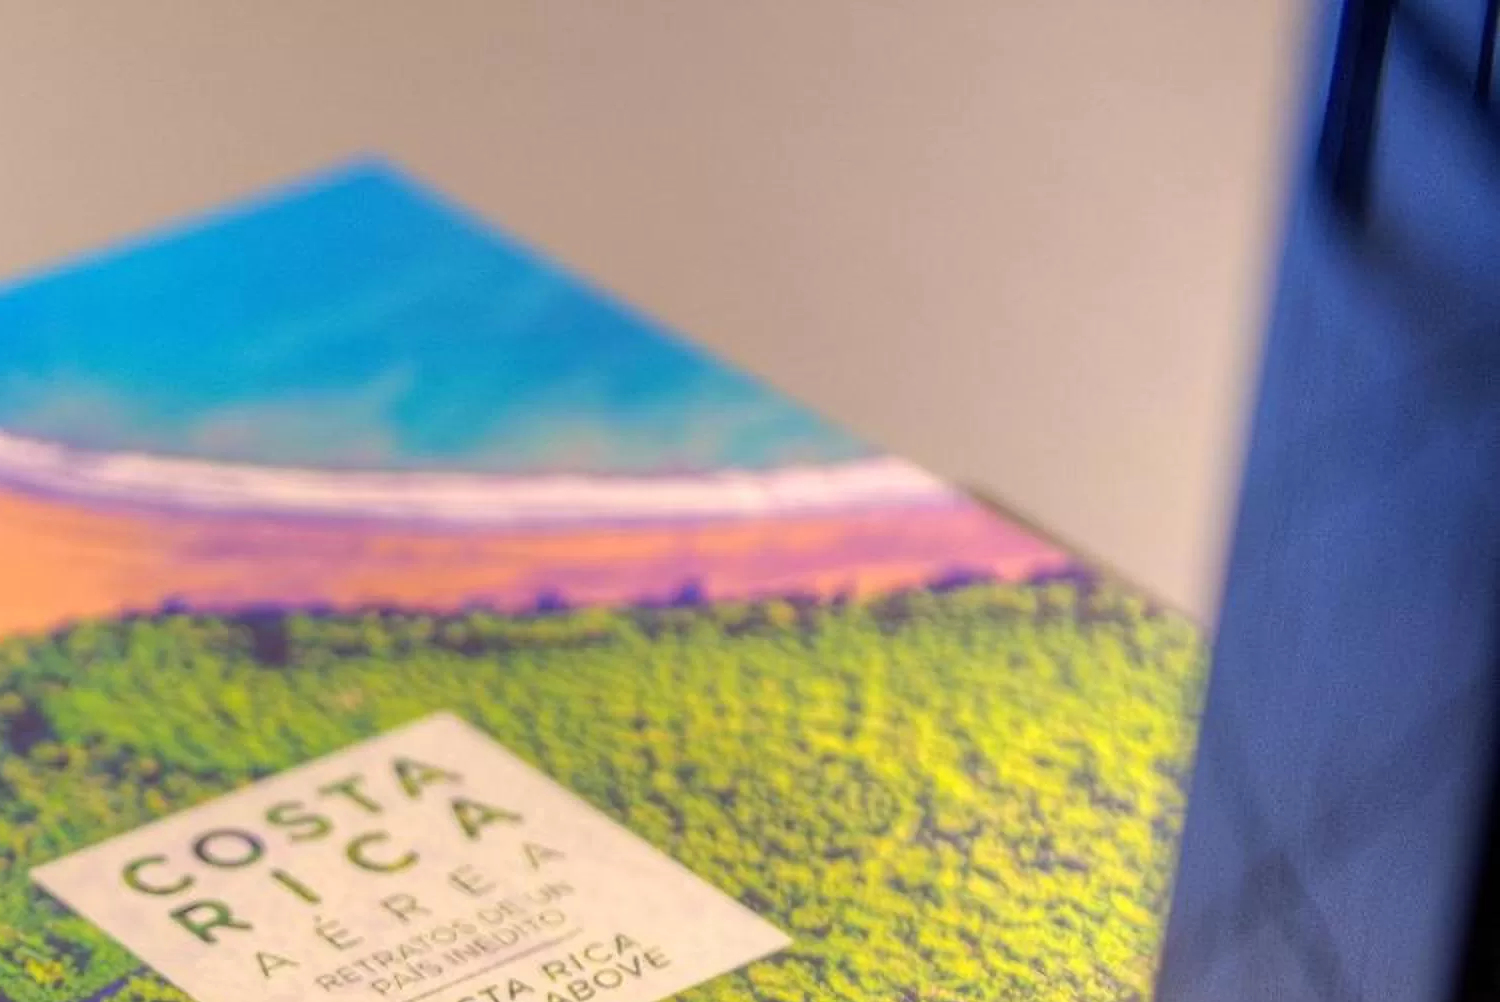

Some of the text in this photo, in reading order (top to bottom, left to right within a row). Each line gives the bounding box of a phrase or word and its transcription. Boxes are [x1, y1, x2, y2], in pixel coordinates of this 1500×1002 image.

[122, 757, 463, 895] COSTA
[170, 797, 524, 945] RICA
[254, 840, 565, 979] AÉREA
[314, 919, 478, 992] RETRATOS
[541, 932, 641, 983] RICA
